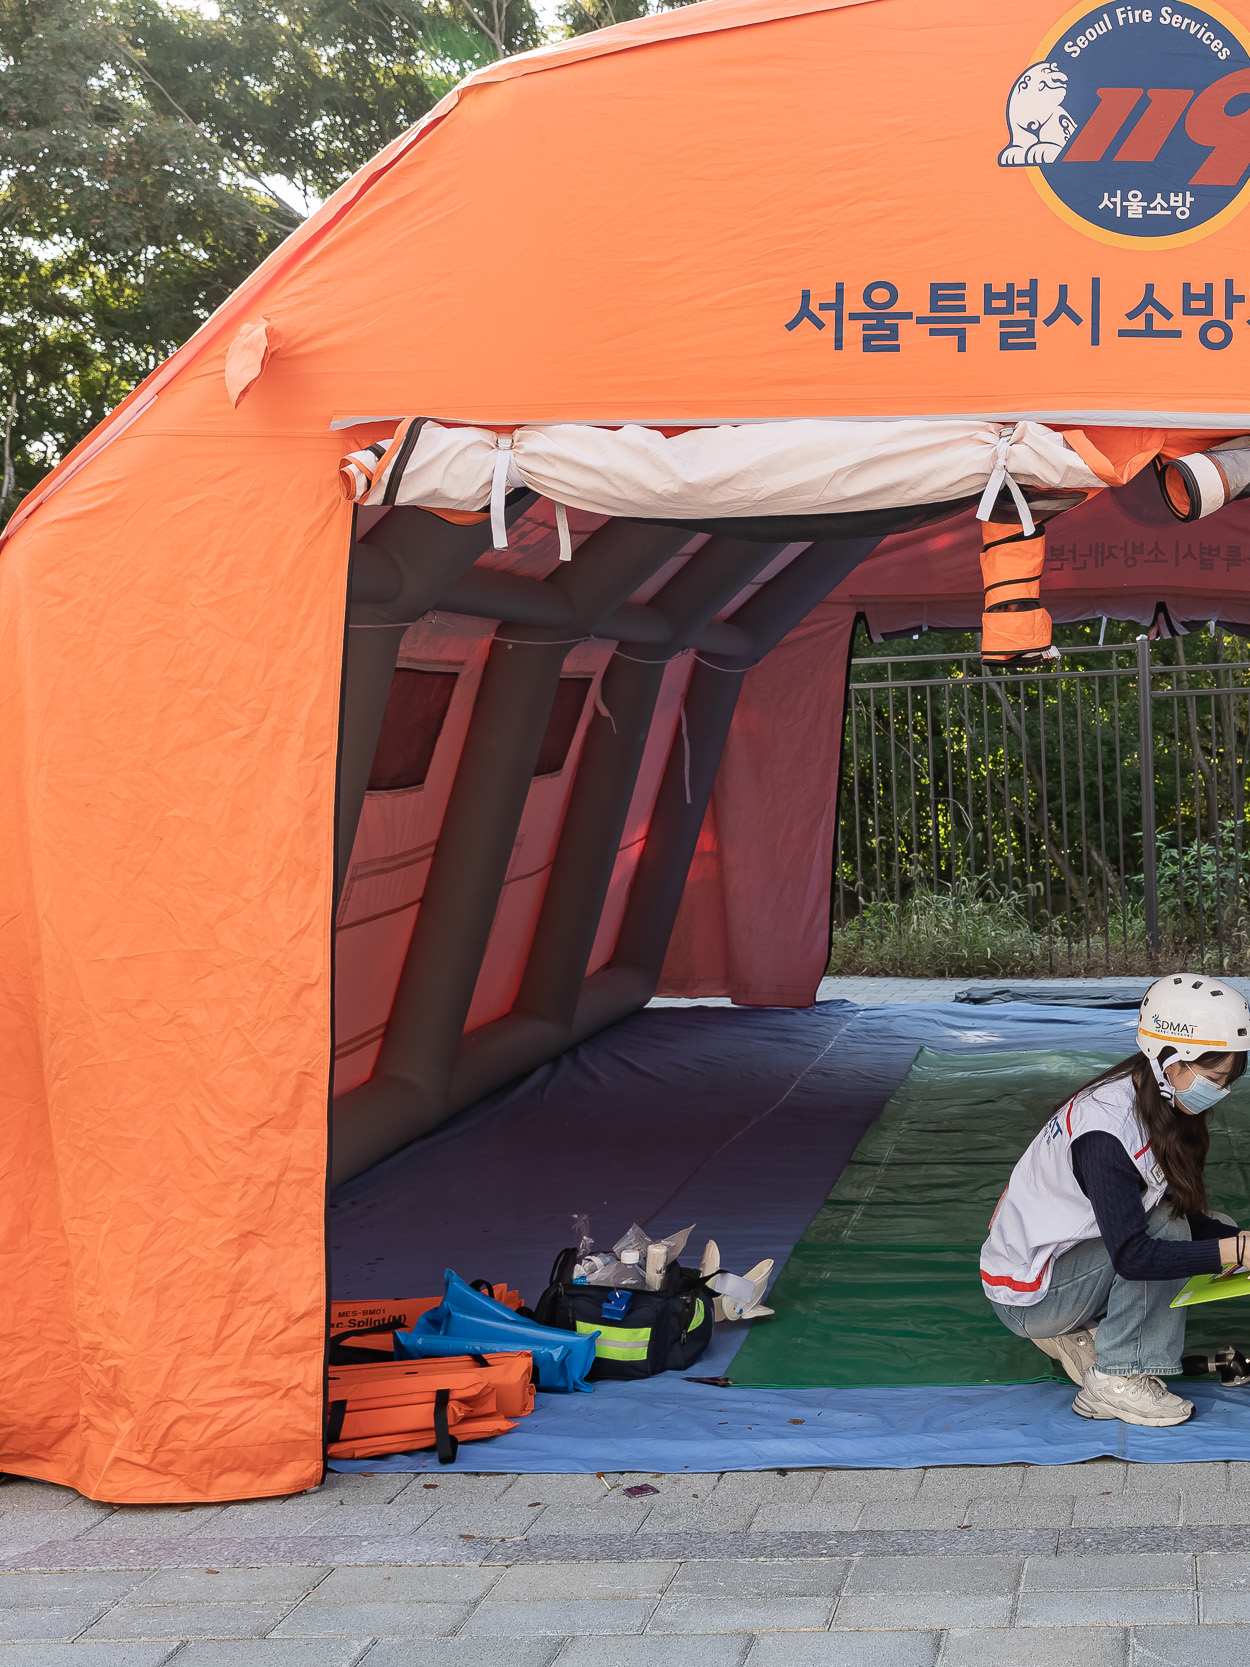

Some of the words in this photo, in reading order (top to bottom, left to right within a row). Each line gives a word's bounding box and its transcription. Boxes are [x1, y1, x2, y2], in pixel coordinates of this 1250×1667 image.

[1064, 13, 1113, 58] Seoul
[1116, 6, 1153, 28] Fire
[1159, 6, 1232, 61] Services
[1098, 190, 1195, 220] 서울소방
[785, 277, 1100, 353] 서울특별시
[1155, 1019, 1198, 1035] SDMAT
[338, 1308, 386, 1318] MES-BM01
